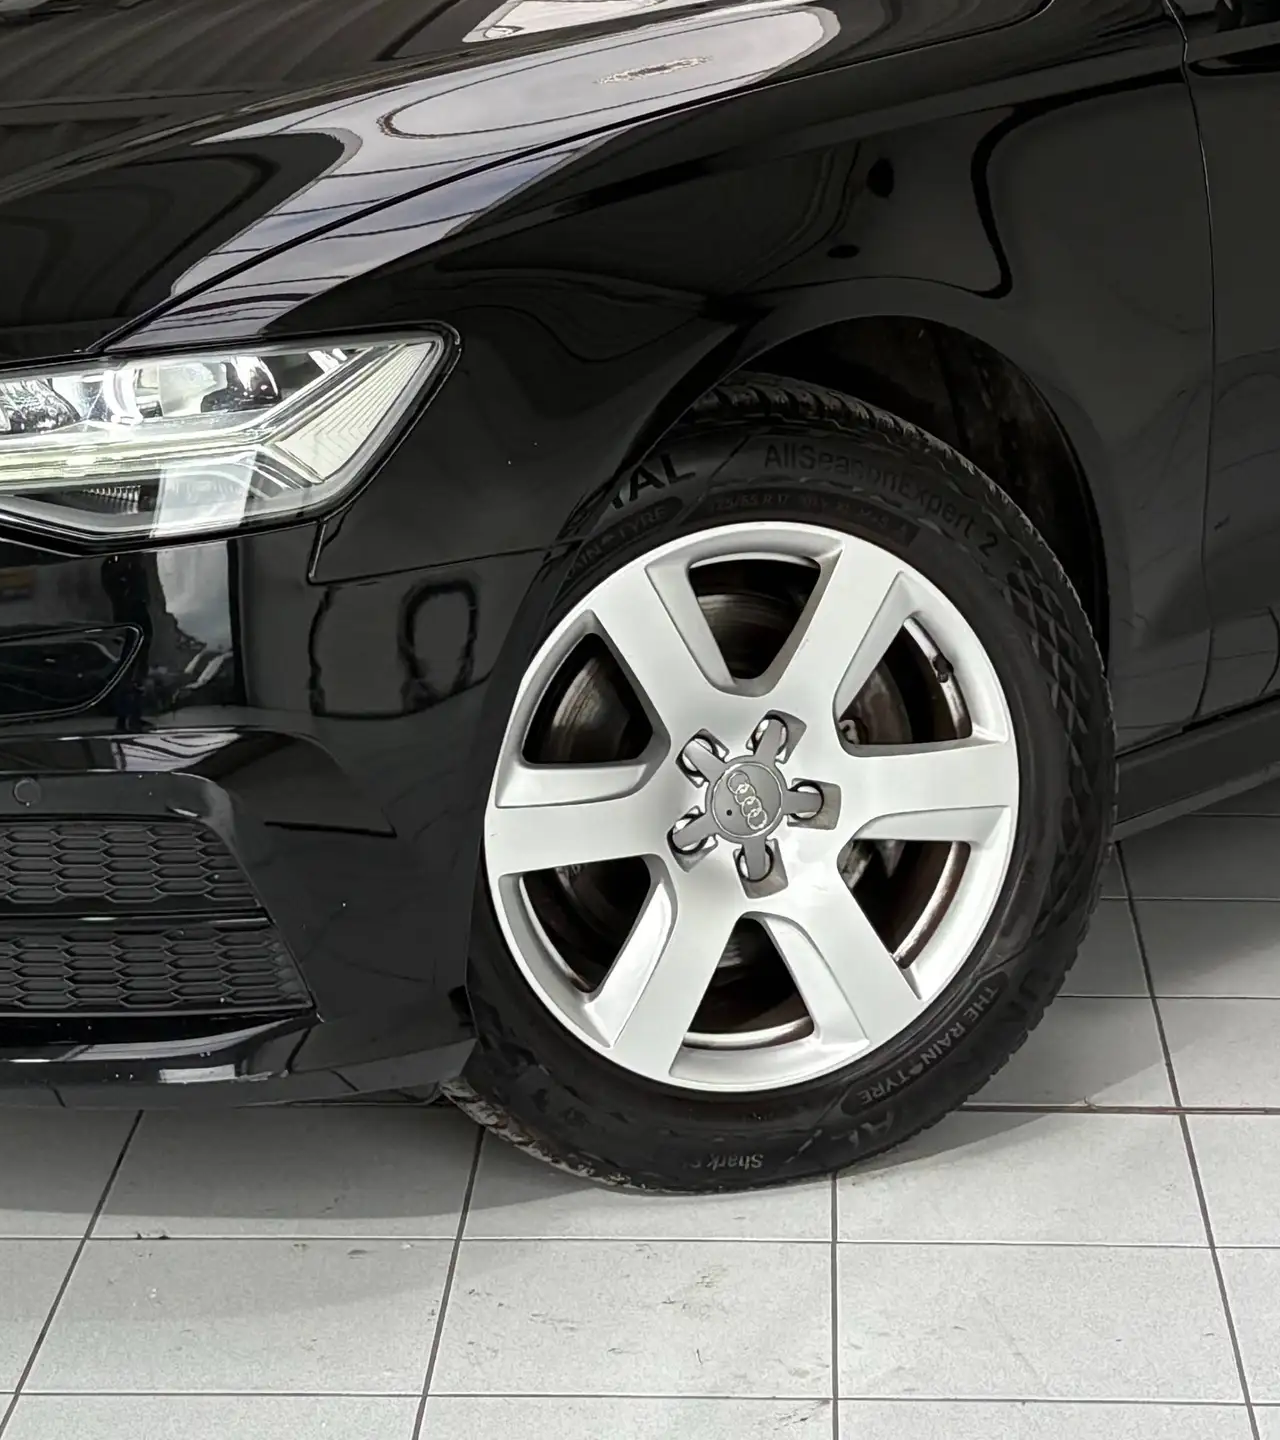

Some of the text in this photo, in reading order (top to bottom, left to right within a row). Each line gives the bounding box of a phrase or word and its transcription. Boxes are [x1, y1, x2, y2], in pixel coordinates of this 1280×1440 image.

[978, 531, 1000, 558] 2
[856, 985, 1000, 1106] THE RAIN TYRE
